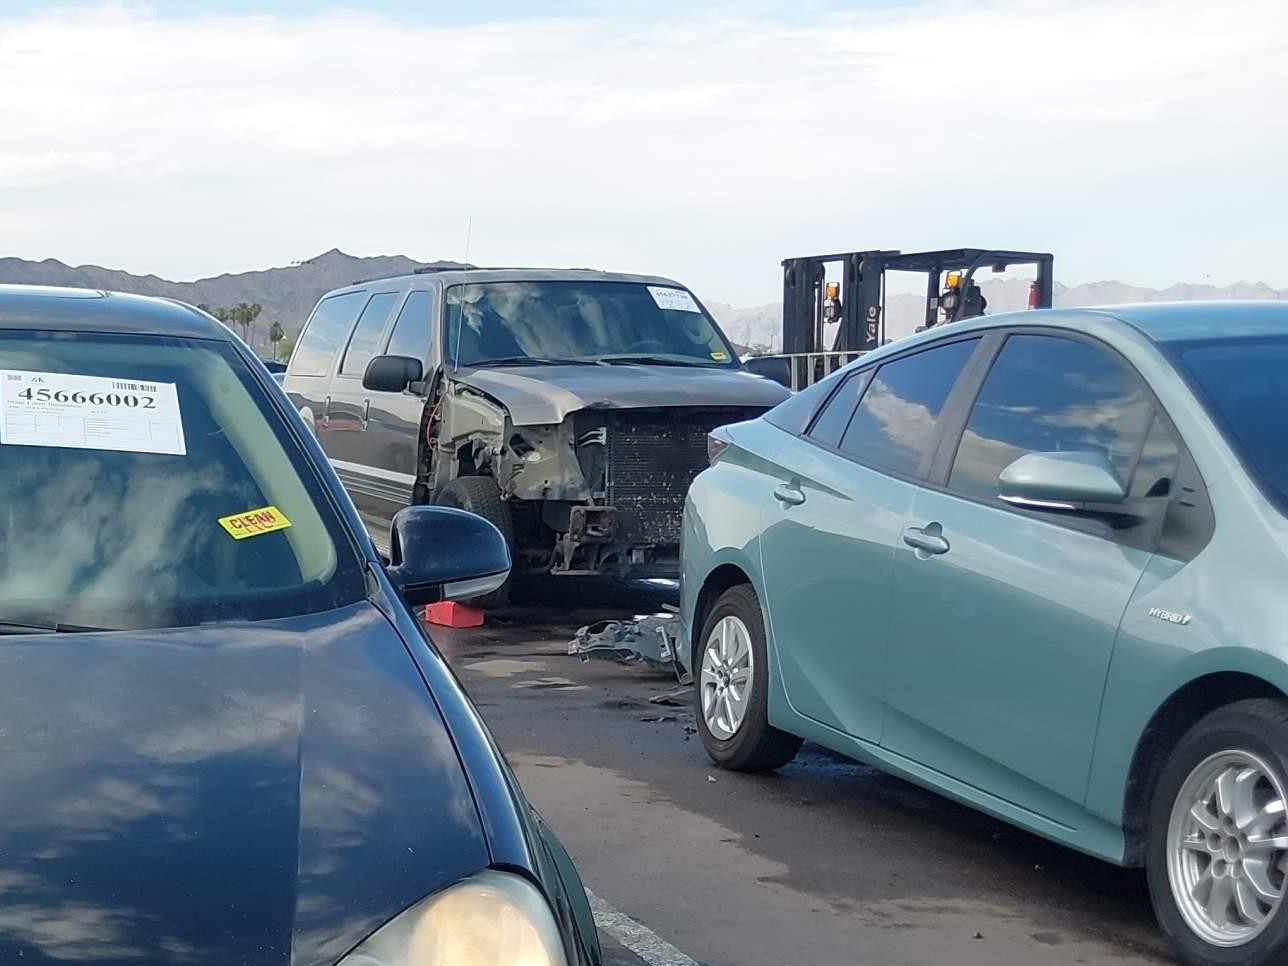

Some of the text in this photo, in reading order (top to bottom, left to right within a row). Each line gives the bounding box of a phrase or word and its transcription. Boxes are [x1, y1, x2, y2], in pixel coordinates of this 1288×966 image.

[866, 306, 877, 343] Yale
[17, 387, 157, 410] 45666002
[1148, 607, 1183, 624] HYBRID
